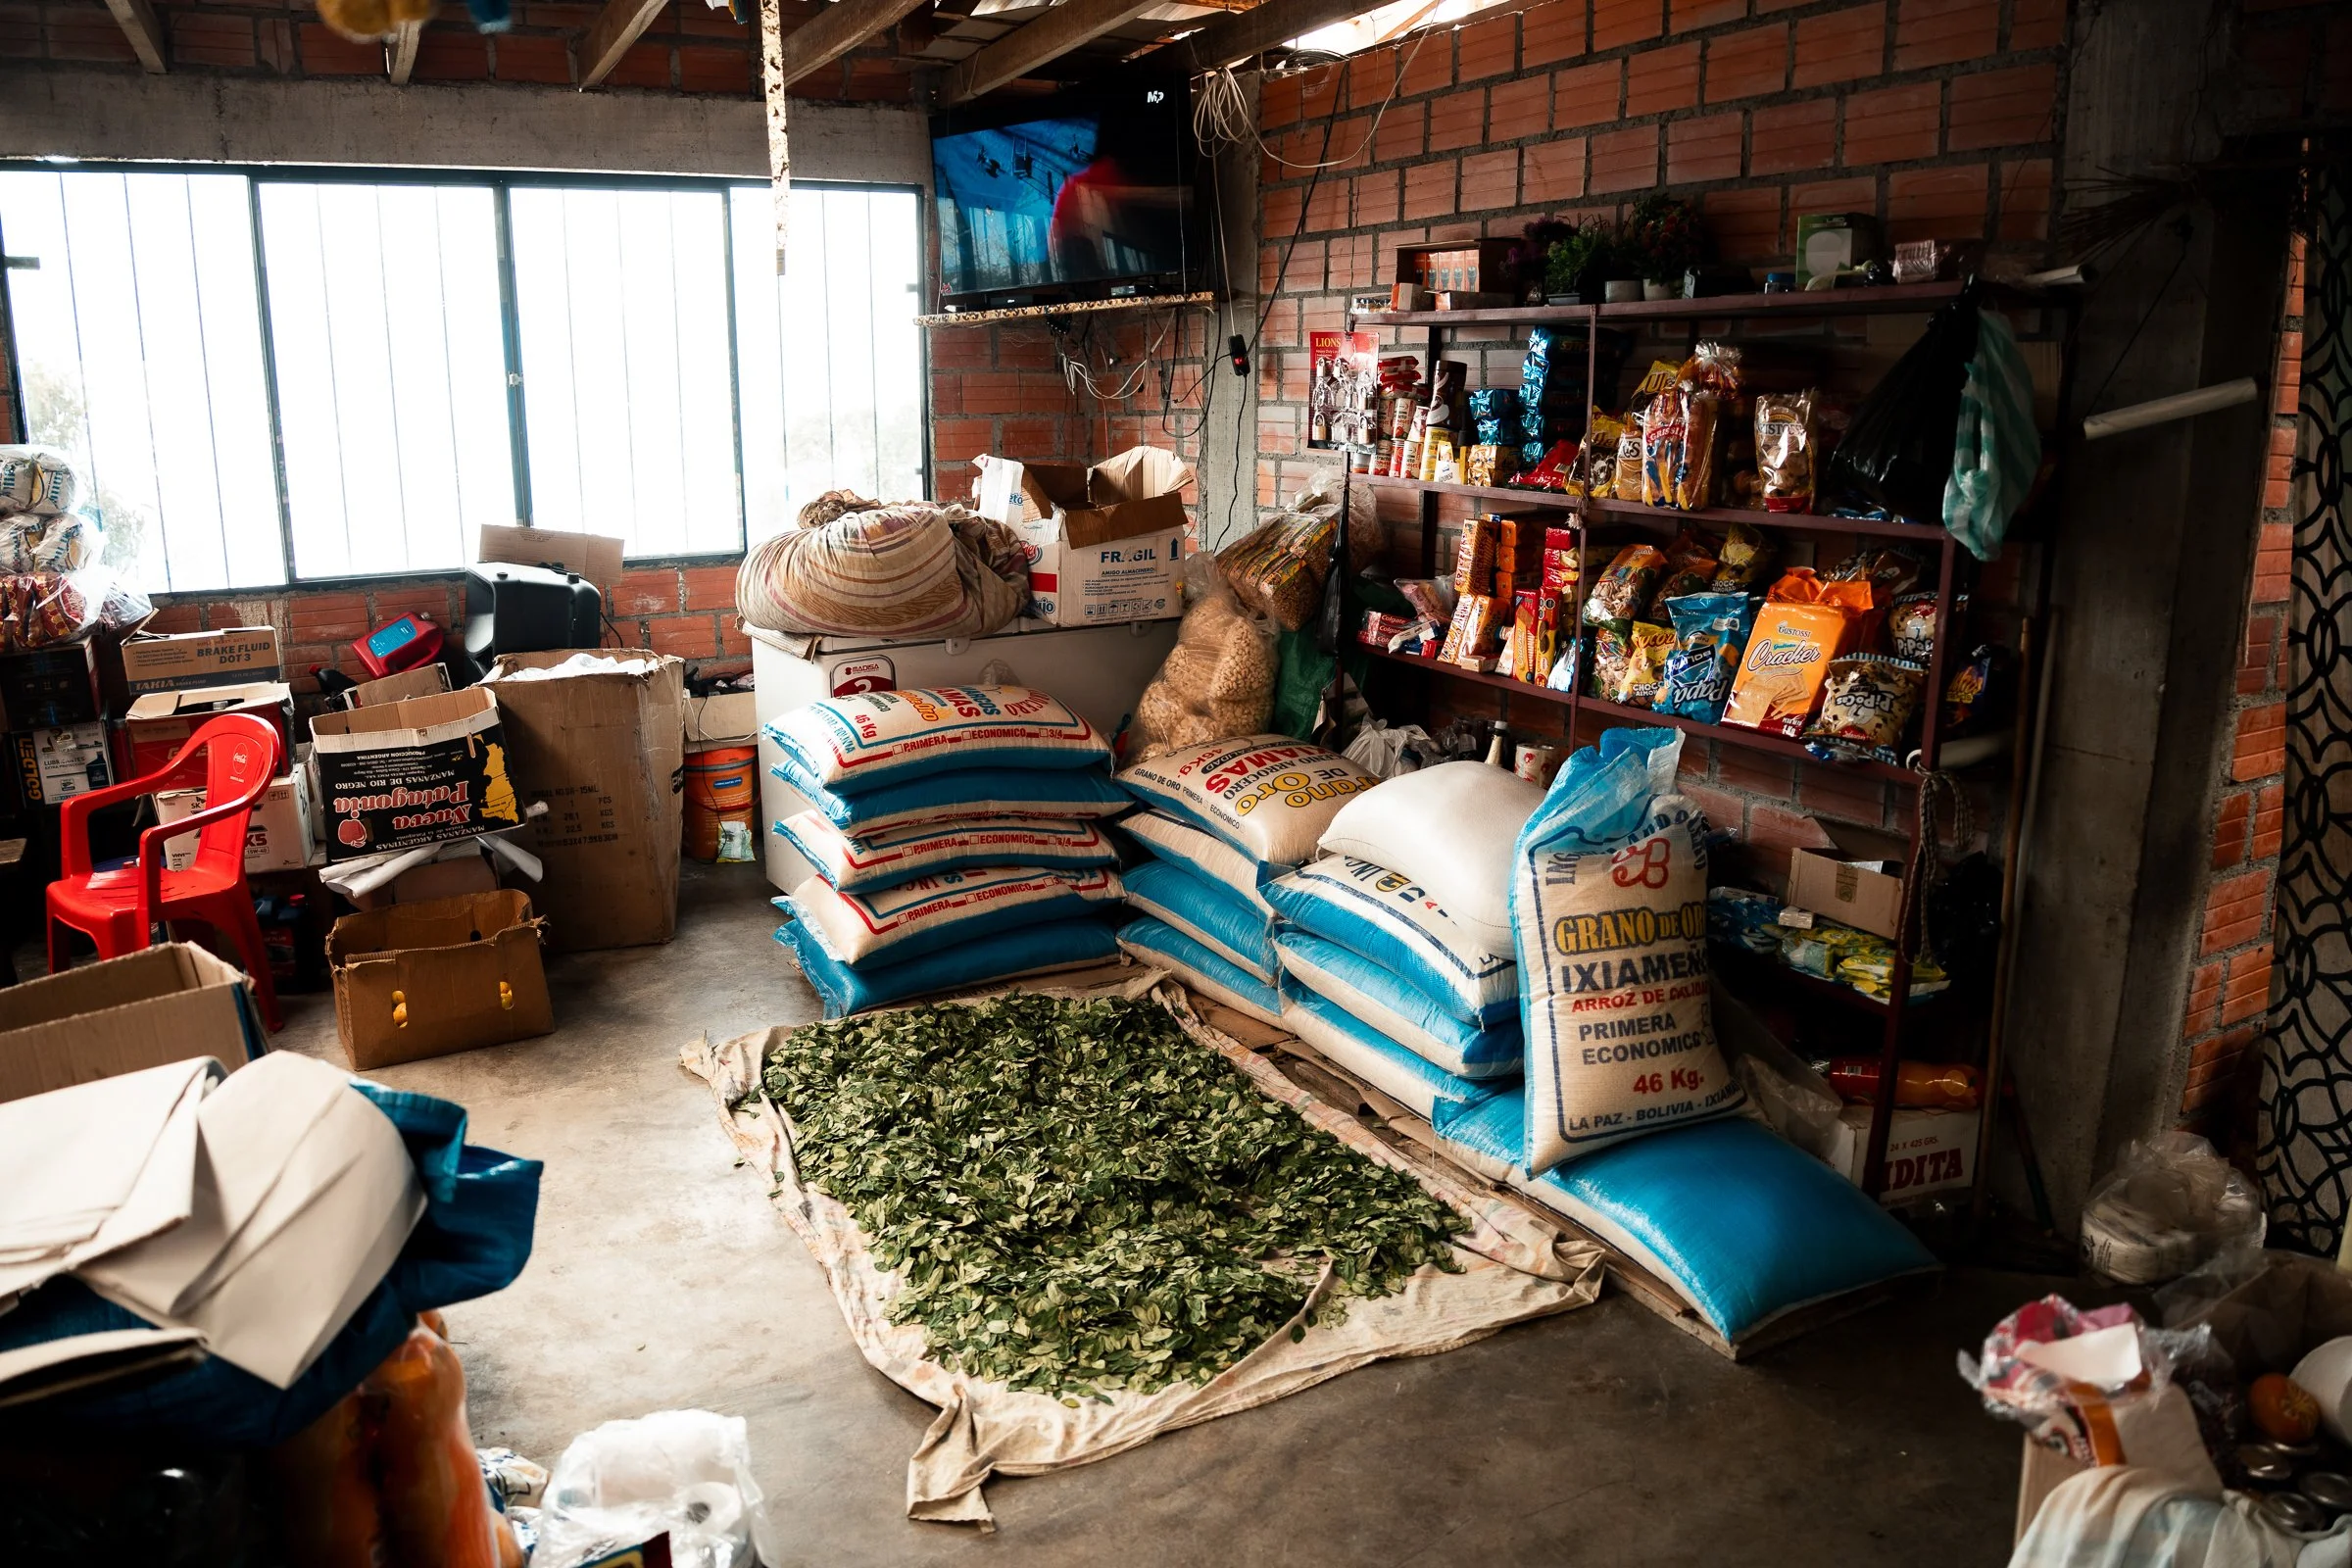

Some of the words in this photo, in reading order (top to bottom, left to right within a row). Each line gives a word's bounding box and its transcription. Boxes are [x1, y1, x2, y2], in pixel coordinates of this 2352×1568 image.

[1315, 337, 1342, 347] LIONS
[1381, 614, 1406, 624] Colgate
[1778, 625, 1811, 638] GUSTOSSI
[197, 643, 236, 658] BRAKE
[237, 641, 270, 655] FLUID
[220, 654, 242, 664] DOT
[242, 653, 252, 662] 3
[1747, 639, 1821, 671] Cracker
[852, 663, 880, 673] MADISA
[855, 714, 871, 724] 46
[913, 703, 939, 722] Oro
[860, 723, 877, 739] Kg
[902, 735, 948, 753] PRIMERA
[971, 727, 1027, 740] ECONOMICO
[1048, 728, 1063, 740] 3/4
[390, 777, 403, 786] DE
[406, 769, 455, 784] MANZANAS
[1134, 767, 1157, 781] GRANO
[1156, 775, 1167, 785] DE
[1165, 779, 1181, 792] ORO
[1223, 760, 1297, 801] ARROCERO
[1313, 767, 1349, 780] DE
[335, 781, 367, 790] NEGRO
[1234, 771, 1311, 817] Oro
[333, 781, 469, 819] Patagonia
[1182, 786, 1203, 805] PRIMERA
[392, 803, 472, 831] Nueva
[601, 821, 615, 830] KGS
[1209, 804, 1240, 830] ECONOMICO
[396, 832, 426, 841] Patagonia
[436, 824, 485, 840] MANZANAS
[376, 835, 433, 851] ARGENTINAS
[912, 837, 958, 856] PRIMERA
[979, 834, 1036, 845] ECONOMICO
[1055, 837, 1072, 847] 3/4
[906, 899, 953, 921] PRIMERA
[976, 883, 1032, 902] ECONOMICO
[1554, 906, 1656, 956] GRANO
[1655, 911, 1681, 939] DE
[1571, 992, 1638, 1013] ARROZ
[1642, 989, 1666, 1005] DE
[1578, 1011, 1677, 1042] PRIMERA
[1582, 1031, 1702, 1065] ECONOMICO
[1633, 1073, 1664, 1095] 46
[1671, 1067, 1705, 1091] Kg.
[1569, 1117, 1591, 1131] LA
[1593, 1112, 1624, 1128] PAZ
[1636, 1101, 1694, 1122] BOLIVIA
[1889, 1142, 1899, 1152] 24
[1910, 1138, 1924, 1149] 425
[1881, 1148, 1963, 1193] IDITA
